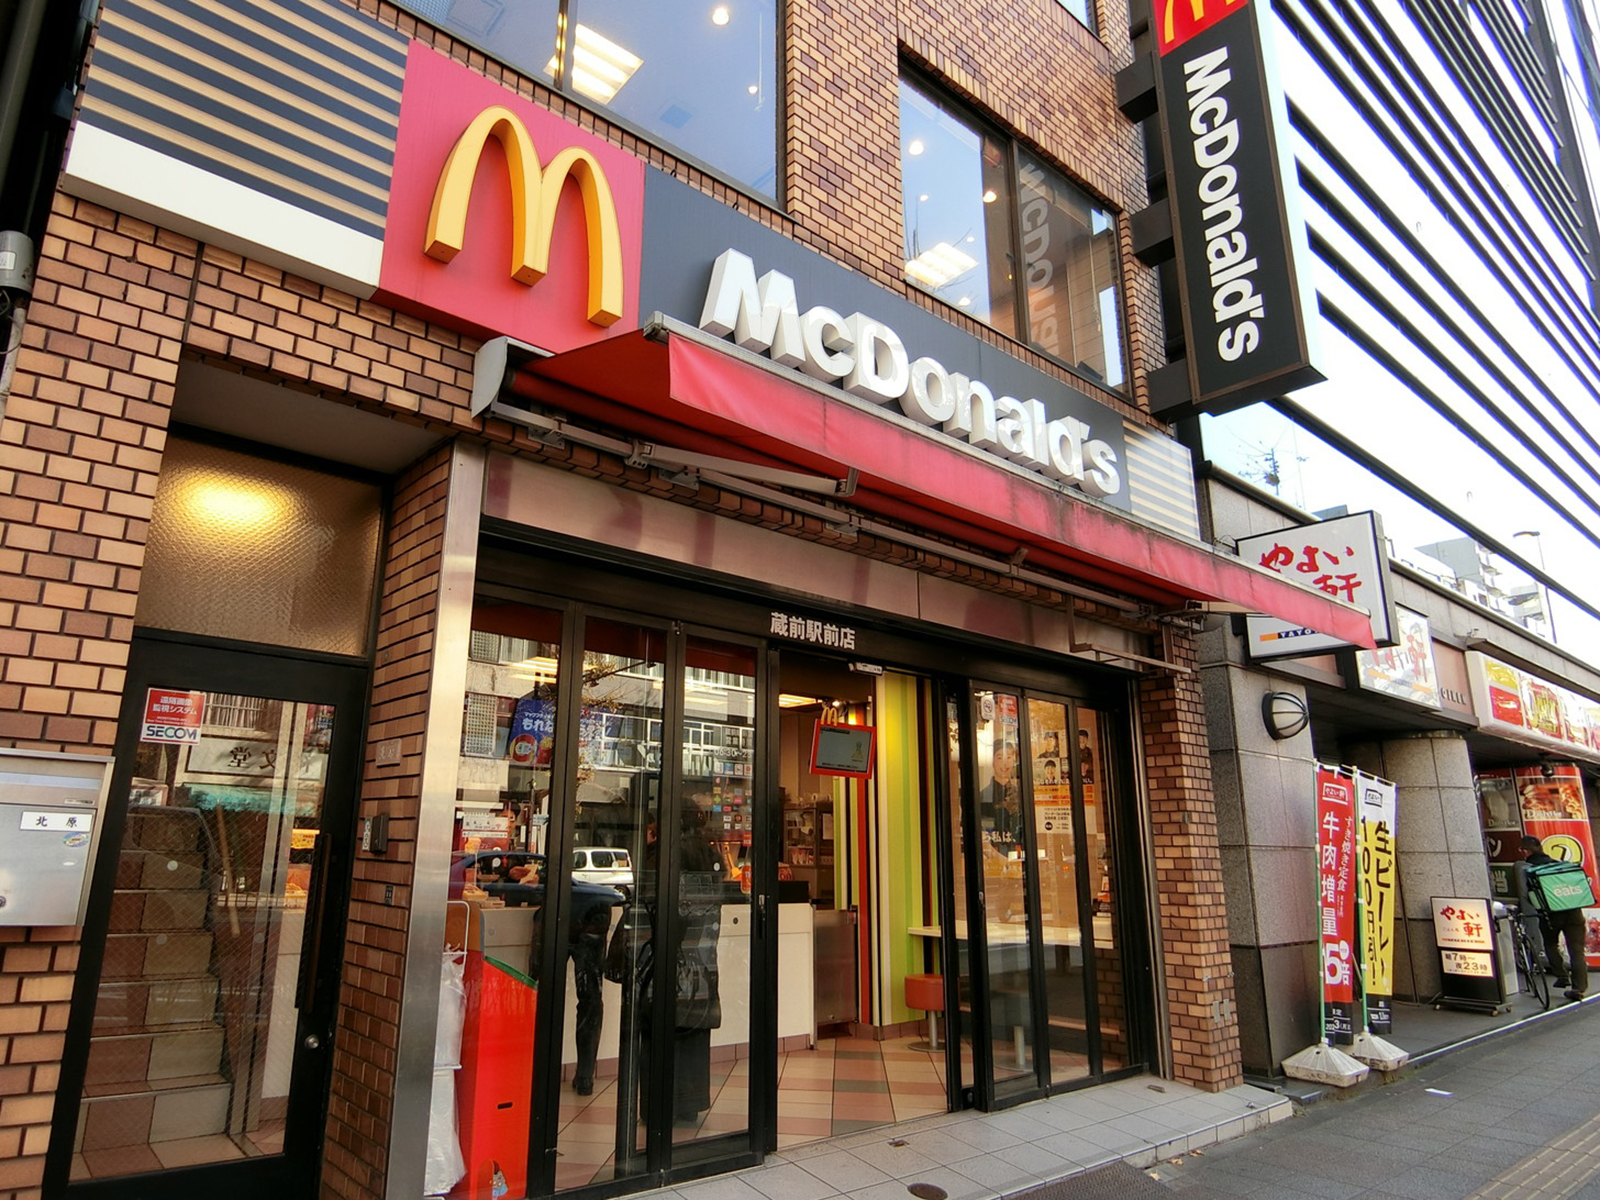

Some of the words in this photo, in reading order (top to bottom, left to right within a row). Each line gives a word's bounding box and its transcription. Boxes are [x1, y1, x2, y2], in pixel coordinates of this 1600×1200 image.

[1183, 46, 1265, 362] McDonald's
[700, 247, 1121, 498] McDonald's
[770, 612, 856, 650] 蔵前駅前店
[1280, 628, 1318, 639] YAYO
[146, 725, 198, 740] SECOM
[1321, 811, 1340, 937] 牛肉増量
[1553, 885, 1583, 897] eats
[1440, 905, 1480, 921] やよい
[1463, 922, 1483, 937] 軒
